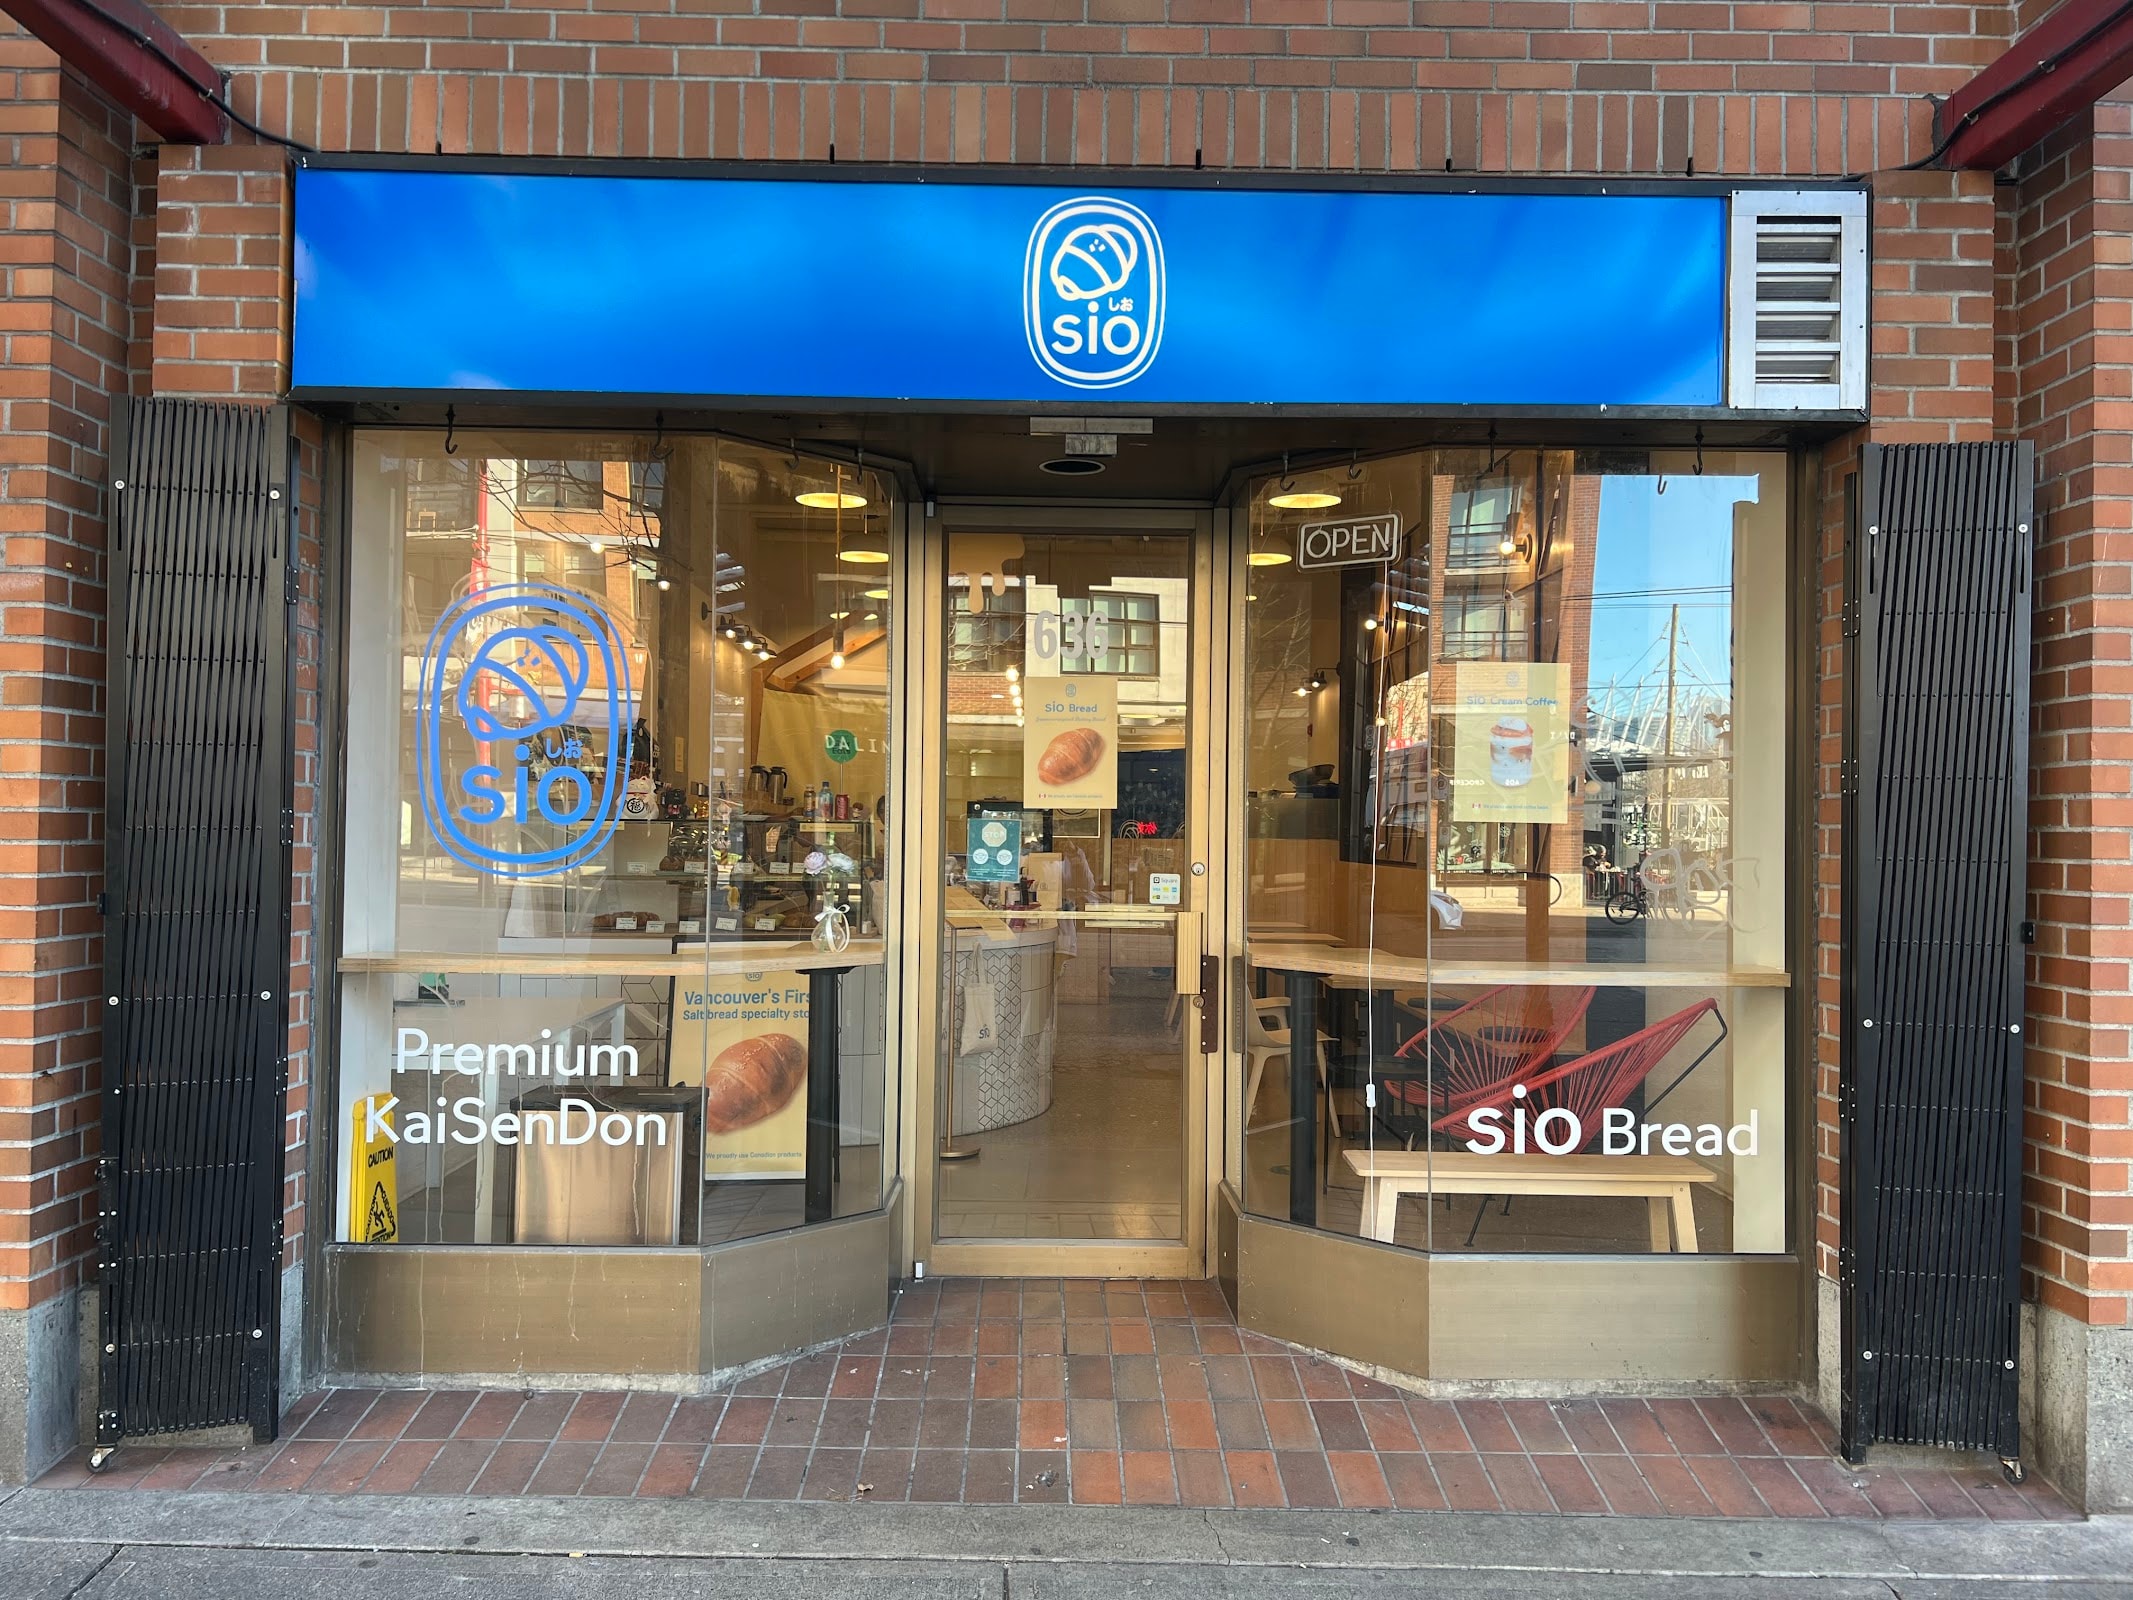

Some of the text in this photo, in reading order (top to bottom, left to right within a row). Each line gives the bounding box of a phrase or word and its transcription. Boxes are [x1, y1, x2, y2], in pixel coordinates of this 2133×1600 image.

[1108, 297, 1134, 312] しお
[1306, 522, 1390, 558] OPEN
[1034, 610, 1109, 659] 636
[1069, 703, 1097, 713] Bread
[1491, 696, 1522, 705] Cream
[1526, 697, 1558, 706] Coffee
[545, 738, 583, 759] しお
[684, 988, 780, 1005] Vancouver's
[683, 1009, 705, 1020] Salt
[707, 1009, 738, 1019] bread
[741, 1008, 790, 1021] specialty
[396, 1028, 639, 1077] Premium
[365, 1096, 667, 1146] KaiSenDon
[1602, 1107, 1758, 1156] Bread
[368, 1146, 394, 1168] CAUTION
[716, 1152, 737, 1160] proudly
